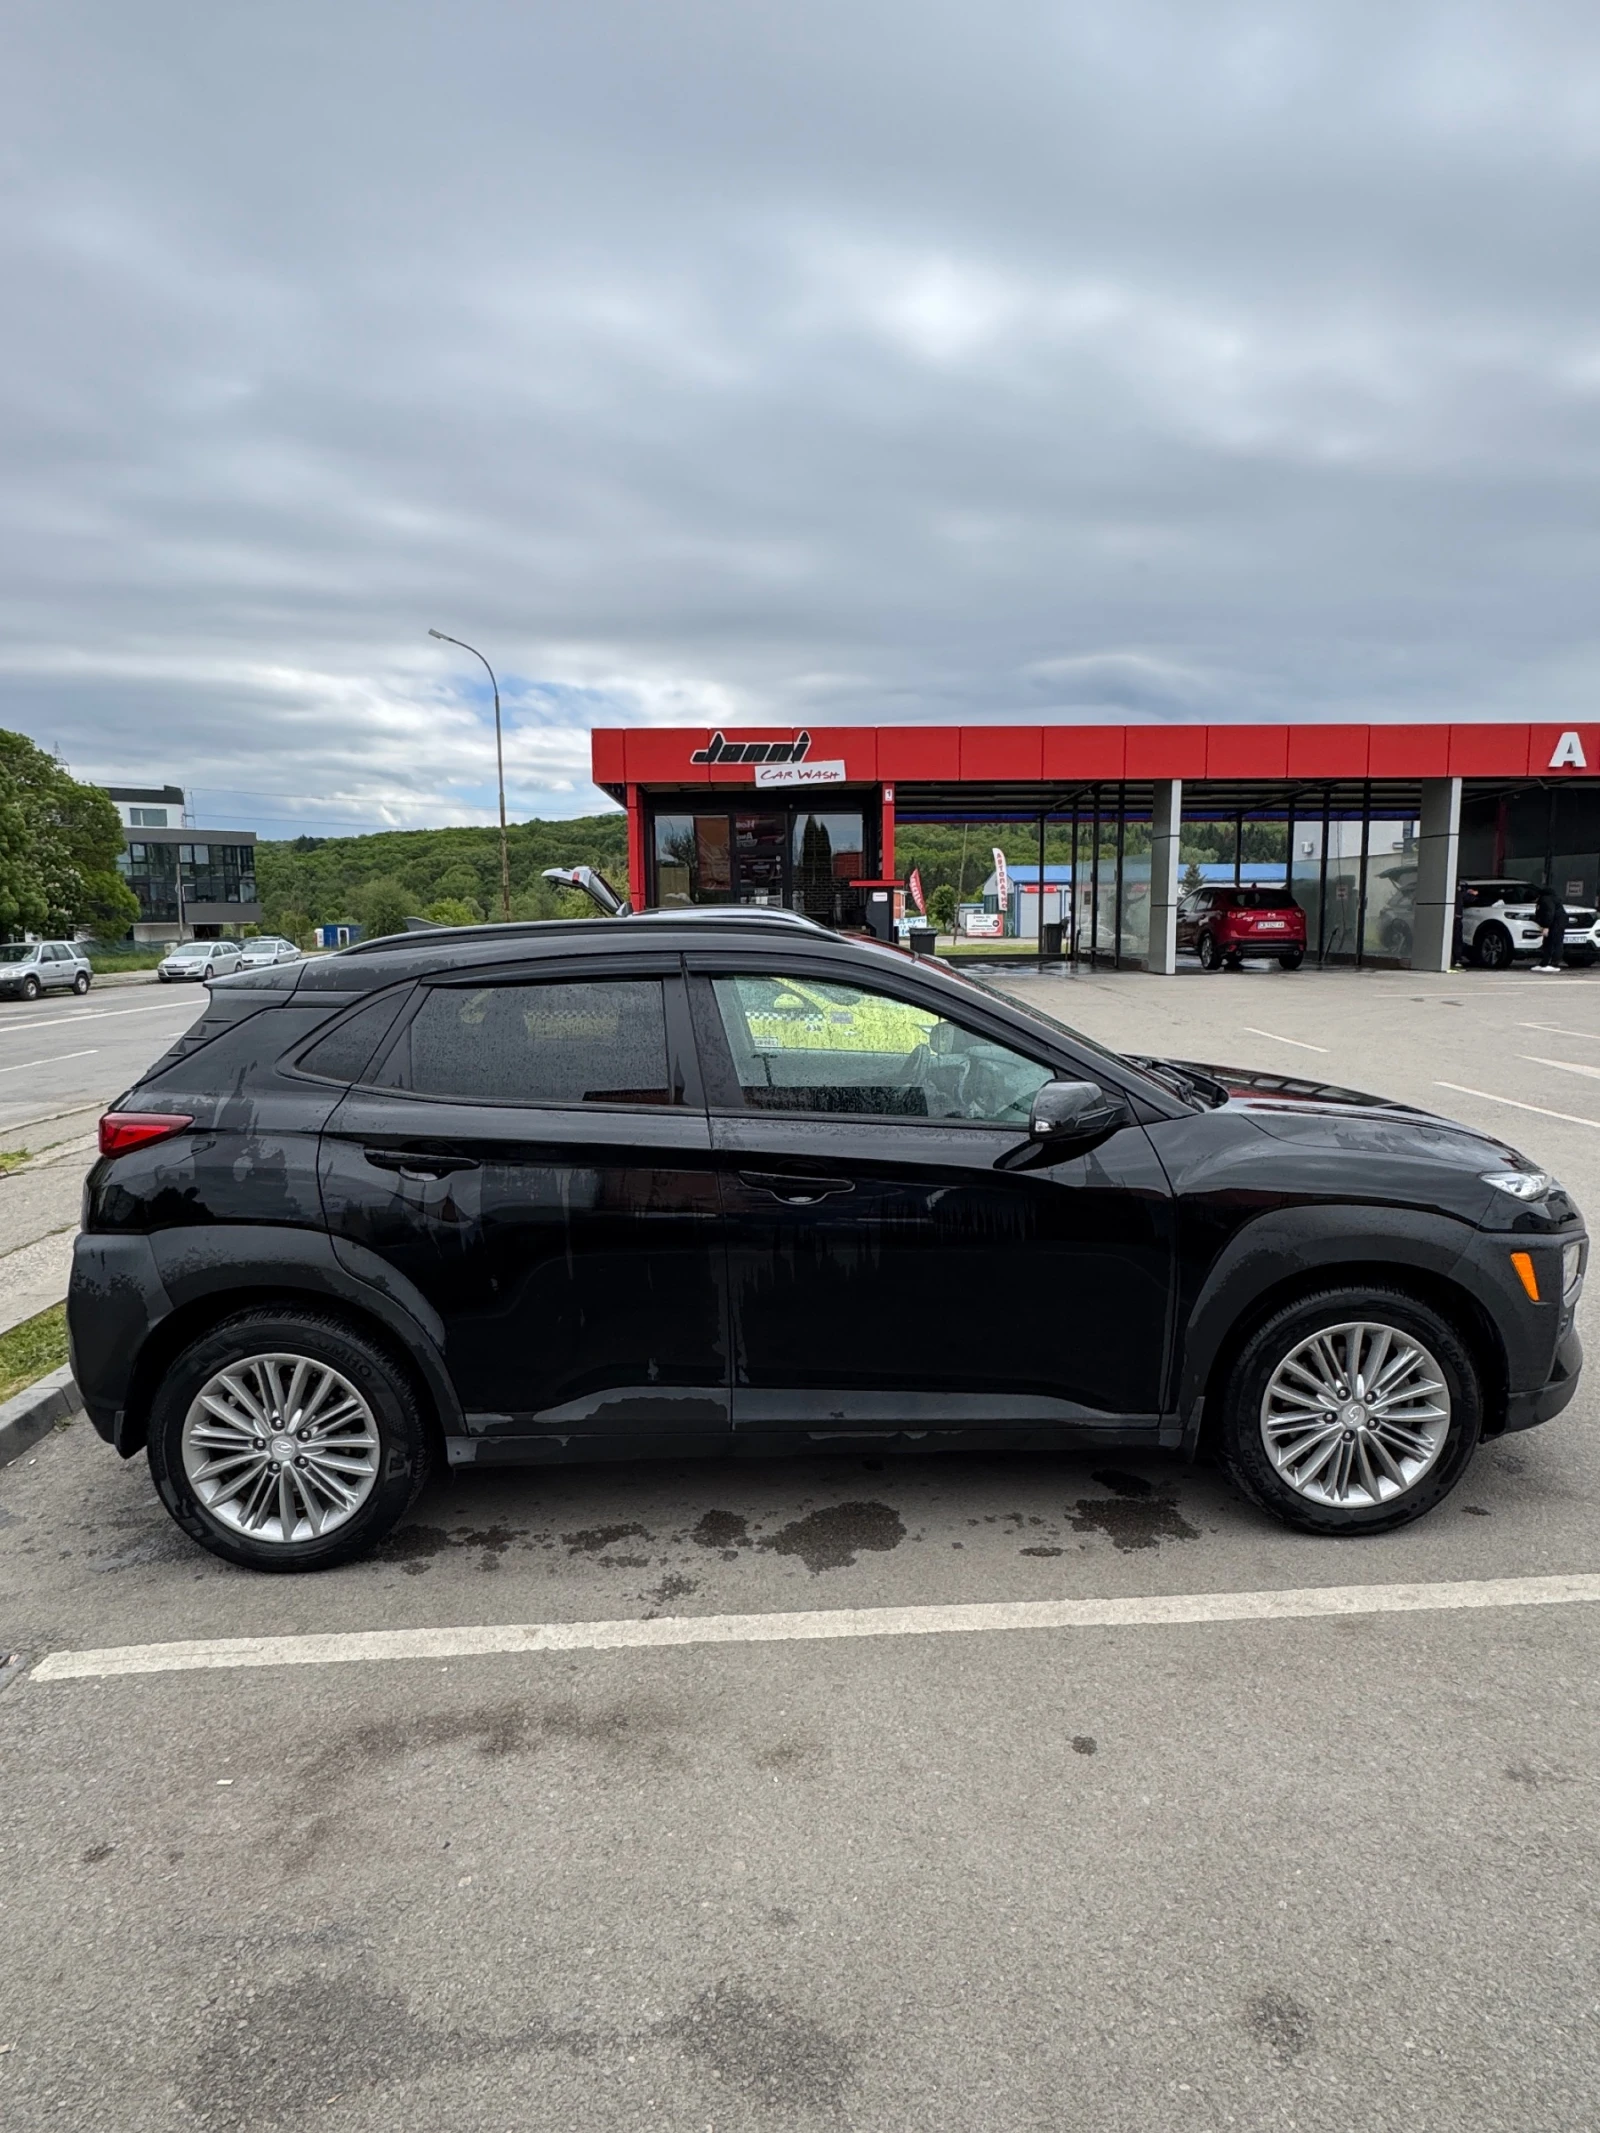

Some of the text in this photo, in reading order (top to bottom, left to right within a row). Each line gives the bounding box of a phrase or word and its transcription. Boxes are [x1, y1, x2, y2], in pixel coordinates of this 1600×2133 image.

[1548, 732, 1588, 767] A
[760, 768, 840, 781] CAR WASH
